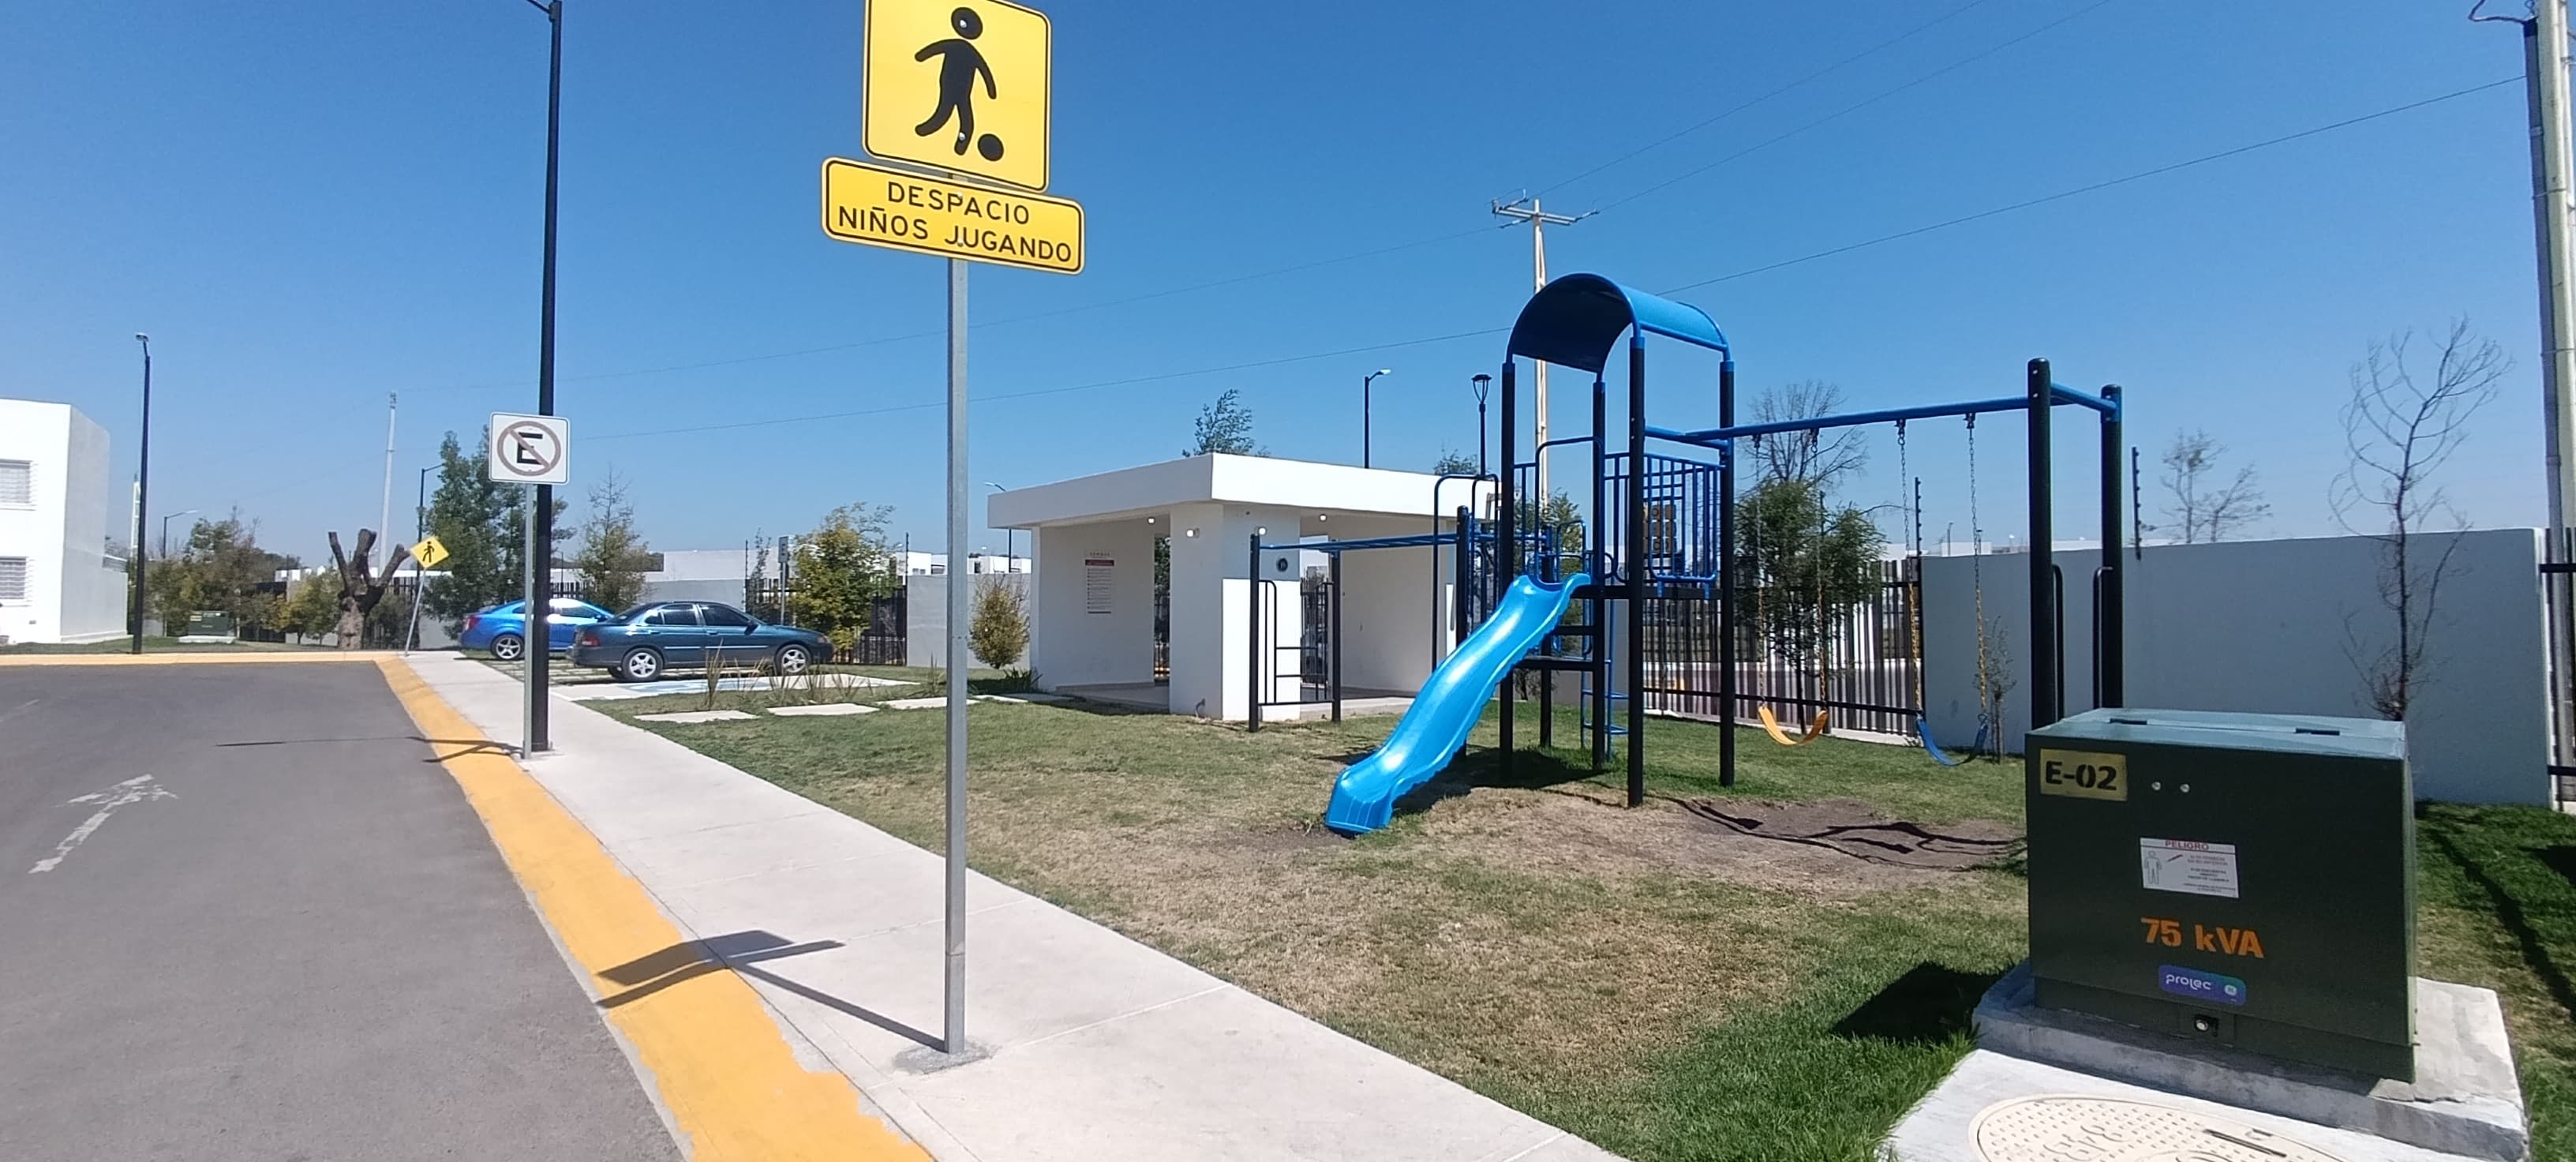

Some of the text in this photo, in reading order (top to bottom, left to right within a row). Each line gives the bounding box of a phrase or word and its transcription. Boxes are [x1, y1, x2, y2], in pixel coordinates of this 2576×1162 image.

[888, 181, 1029, 225] DESPACIO
[838, 206, 1071, 262] NIÑOS JUGANDO
[517, 432, 545, 466] E
[2046, 761, 2117, 791] E-02
[2165, 839, 2210, 851] PELIGRO
[2140, 916, 2264, 958] 75 kVA
[2166, 973, 2212, 991] prolec
